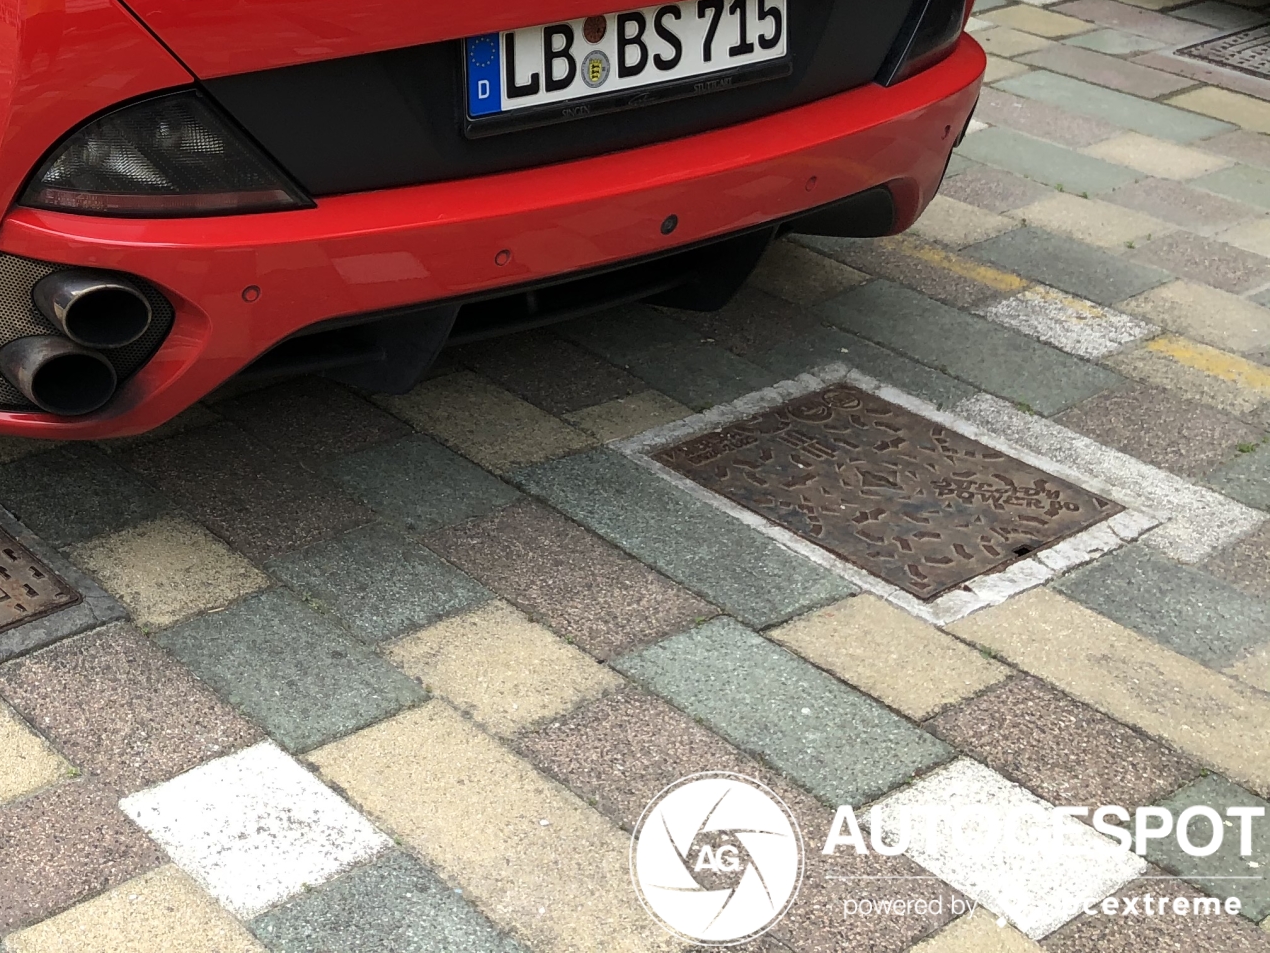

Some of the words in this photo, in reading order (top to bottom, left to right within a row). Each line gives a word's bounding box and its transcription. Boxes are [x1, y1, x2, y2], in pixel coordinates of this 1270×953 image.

[505, 24, 577, 99] LB
[617, 5, 682, 79] BS
[477, 80, 490, 100] D
